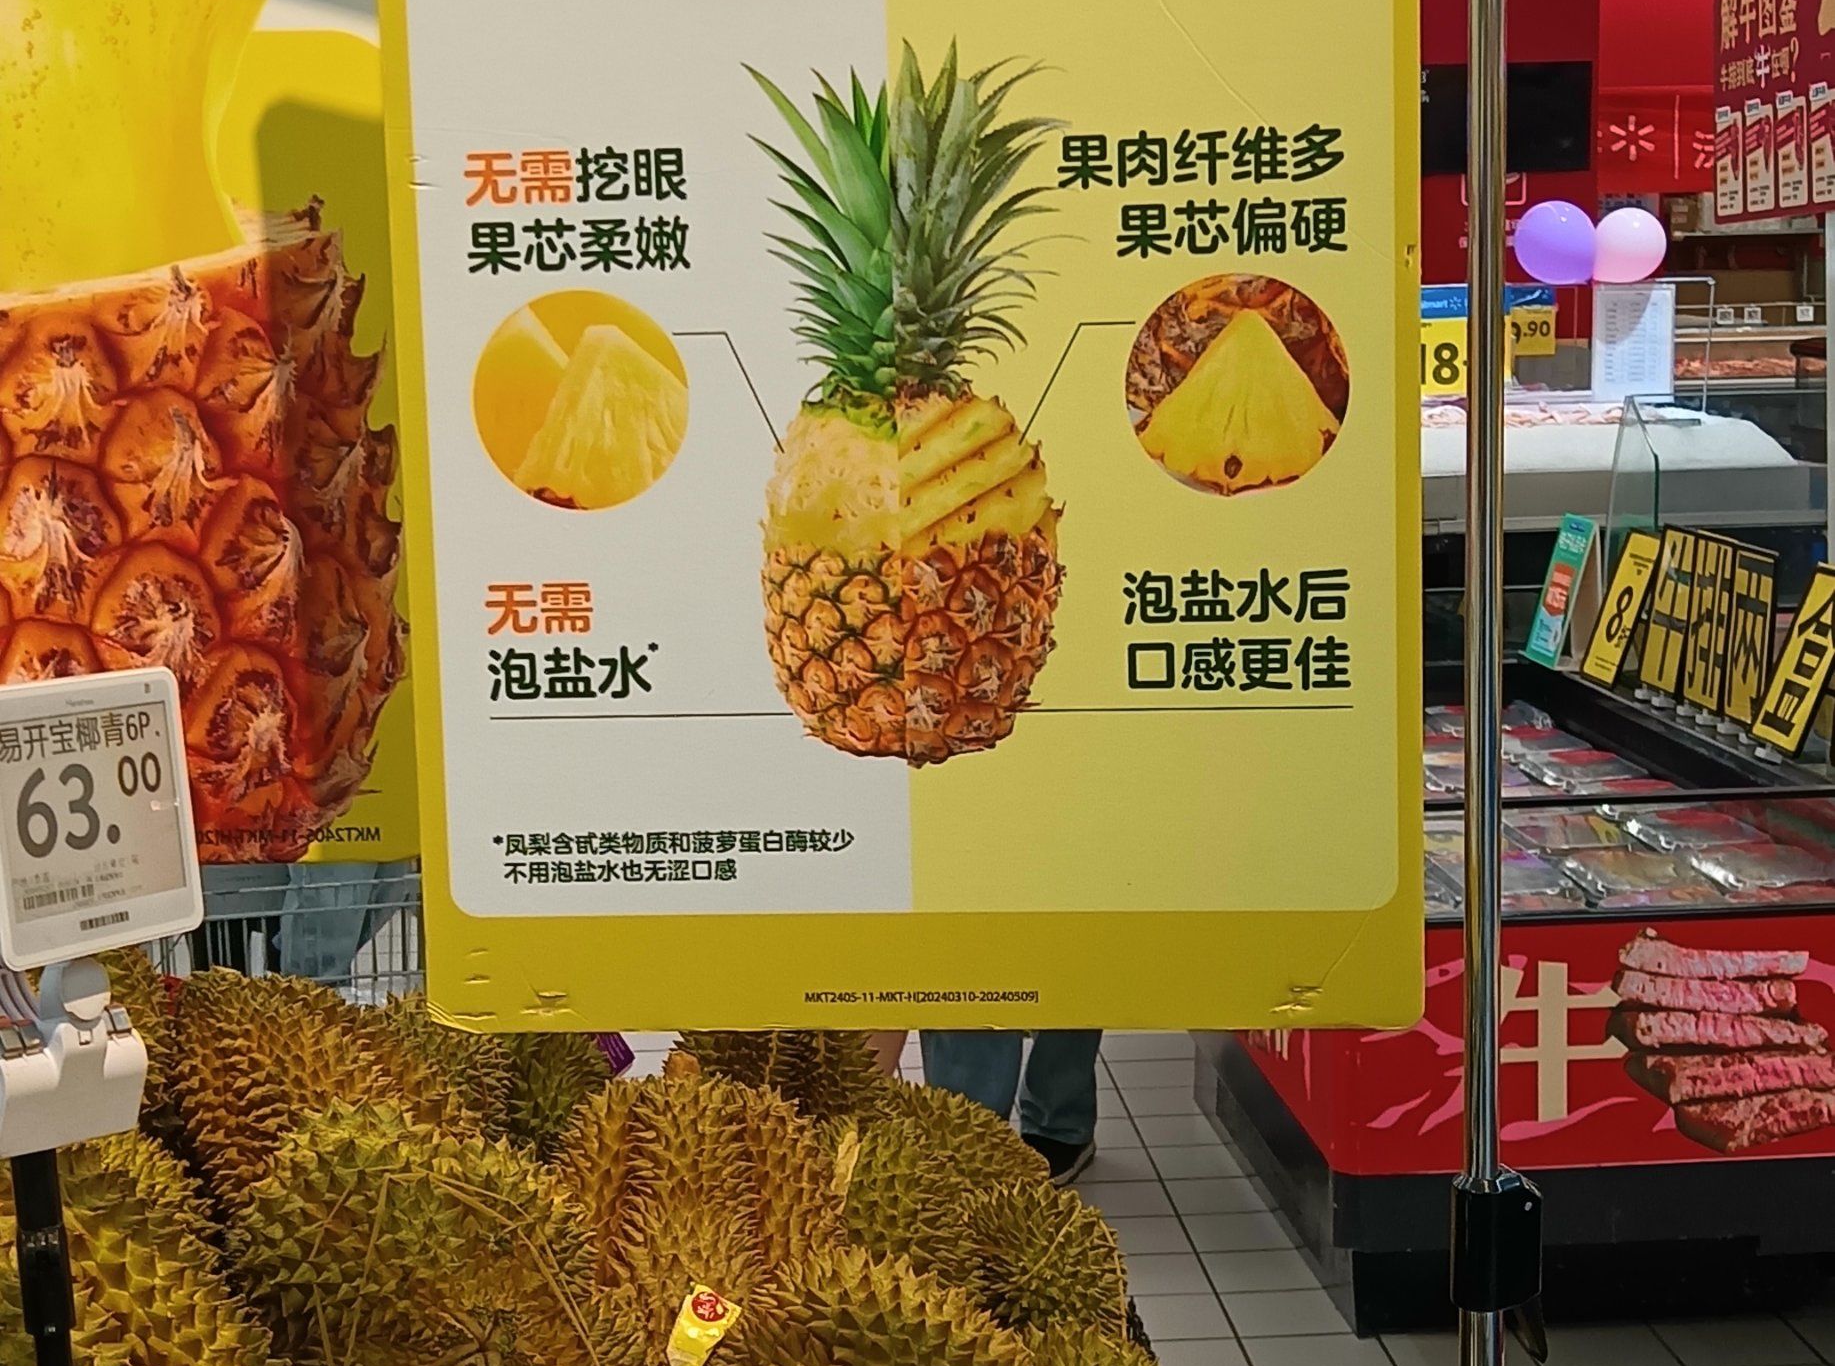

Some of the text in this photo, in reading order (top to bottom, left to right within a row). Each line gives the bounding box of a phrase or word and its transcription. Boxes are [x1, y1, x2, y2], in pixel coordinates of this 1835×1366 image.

[463, 146, 688, 209] 无需挖眼
[1056, 123, 1347, 191] 果肉纤维多
[466, 215, 692, 276] 果芯柔嫩
[1116, 196, 1349, 257] 果芯偏硬
[1421, 299, 1449, 310] lmart
[484, 581, 594, 636] 无需
[1122, 568, 1351, 628] 泡盐水后
[1124, 637, 1354, 694] 口感更佳
[503, 858, 738, 884] 不用泡盐水也无涩口感
[1500, 962, 1631, 1123] 牛
